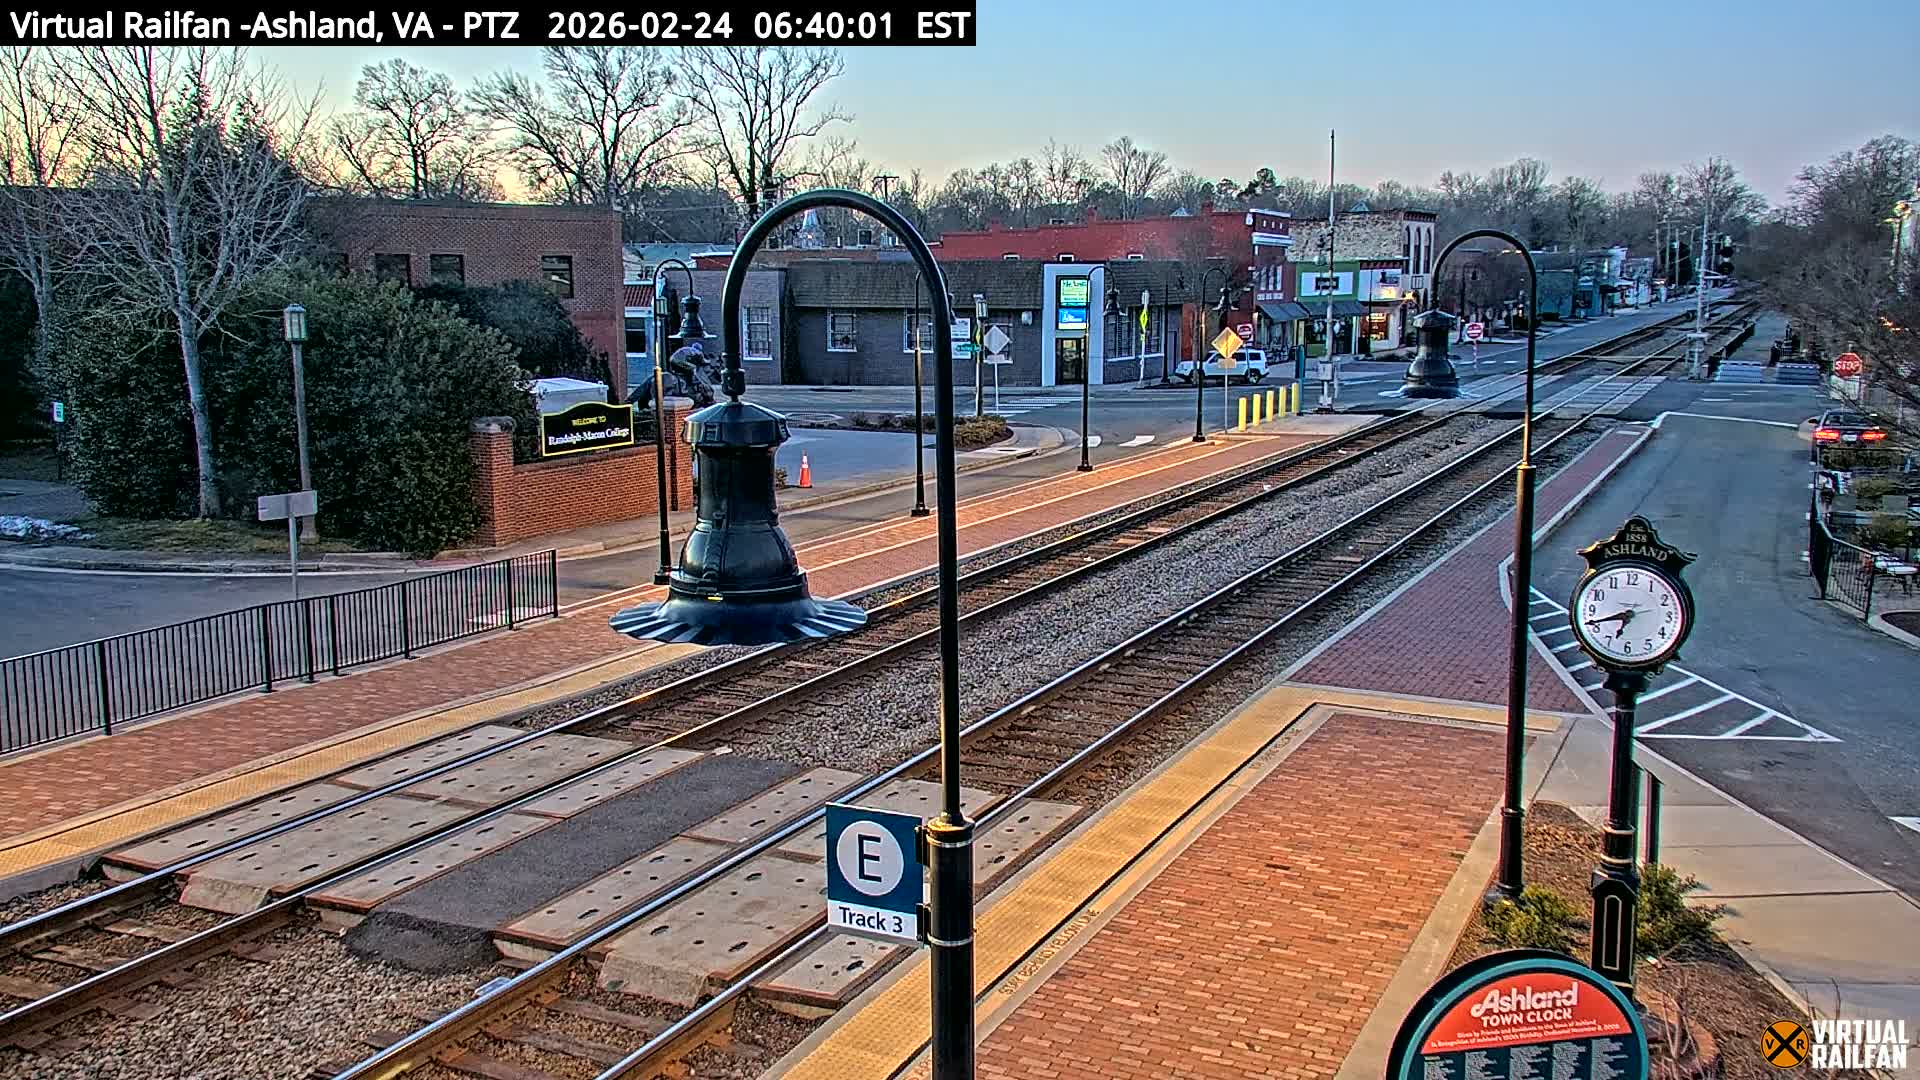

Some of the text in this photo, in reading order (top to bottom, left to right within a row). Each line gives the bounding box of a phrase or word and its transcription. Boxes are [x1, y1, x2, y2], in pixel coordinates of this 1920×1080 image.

[1835, 360, 1860, 371] STOP
[548, 427, 630, 445] Randolph-Macon College
[1626, 533, 1648, 543] 1858
[1603, 543, 1668, 562] ASHLAND
[1609, 577, 1618, 589] 11
[1626, 573, 1639, 586] 12
[1648, 580, 1654, 593] 1
[1593, 590, 1605, 602] 10
[1660, 594, 1669, 606] 2
[1588, 604, 1596, 617] 9
[1665, 611, 1673, 624] 3
[1592, 621, 1600, 633] 8
[1658, 626, 1666, 639] 4
[1604, 635, 1613, 647] 7
[1623, 641, 1632, 654] 6
[1644, 638, 1653, 651] 5
[857, 833, 882, 883] E
[839, 906, 903, 933] Track 3
[1470, 982, 1579, 1018] Ashland
[1481, 1008, 1573, 1027] TOWN CLOCK
